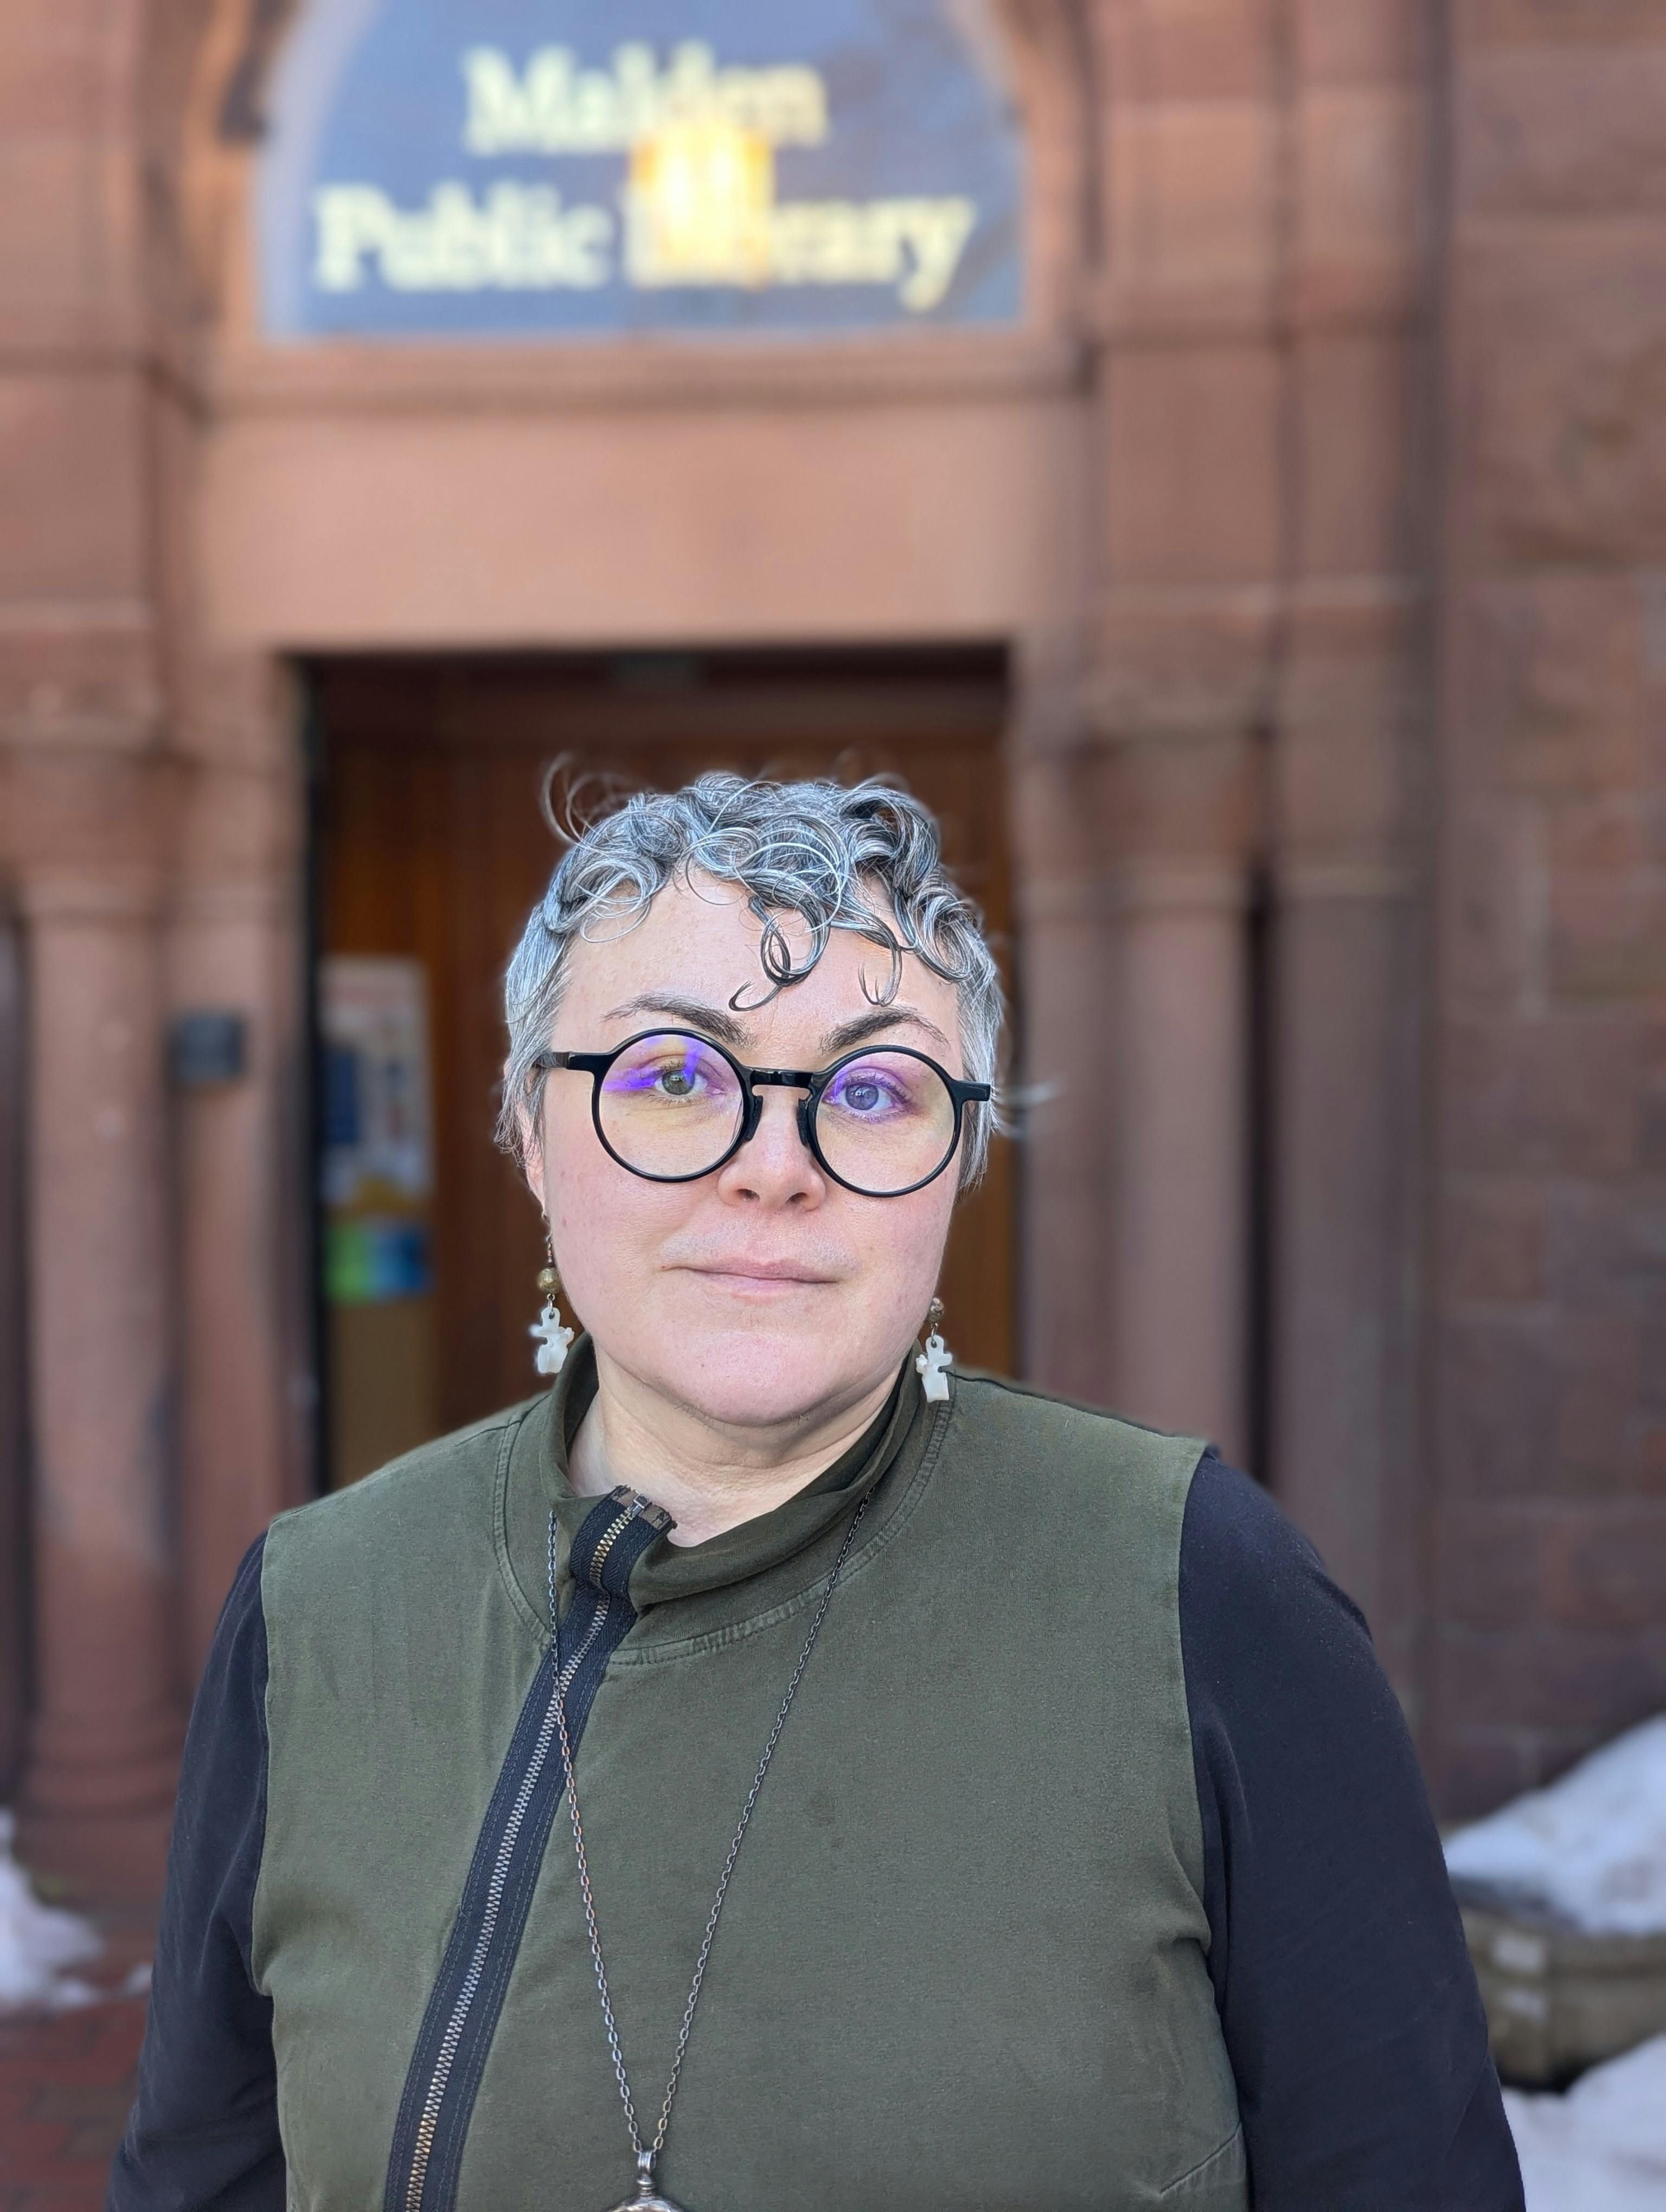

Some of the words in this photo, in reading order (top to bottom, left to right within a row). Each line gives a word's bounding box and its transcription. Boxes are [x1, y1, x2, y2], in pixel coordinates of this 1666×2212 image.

[464, 41, 828, 154] Malden
[315, 182, 614, 292] Public
[621, 180, 977, 311] Lrary
